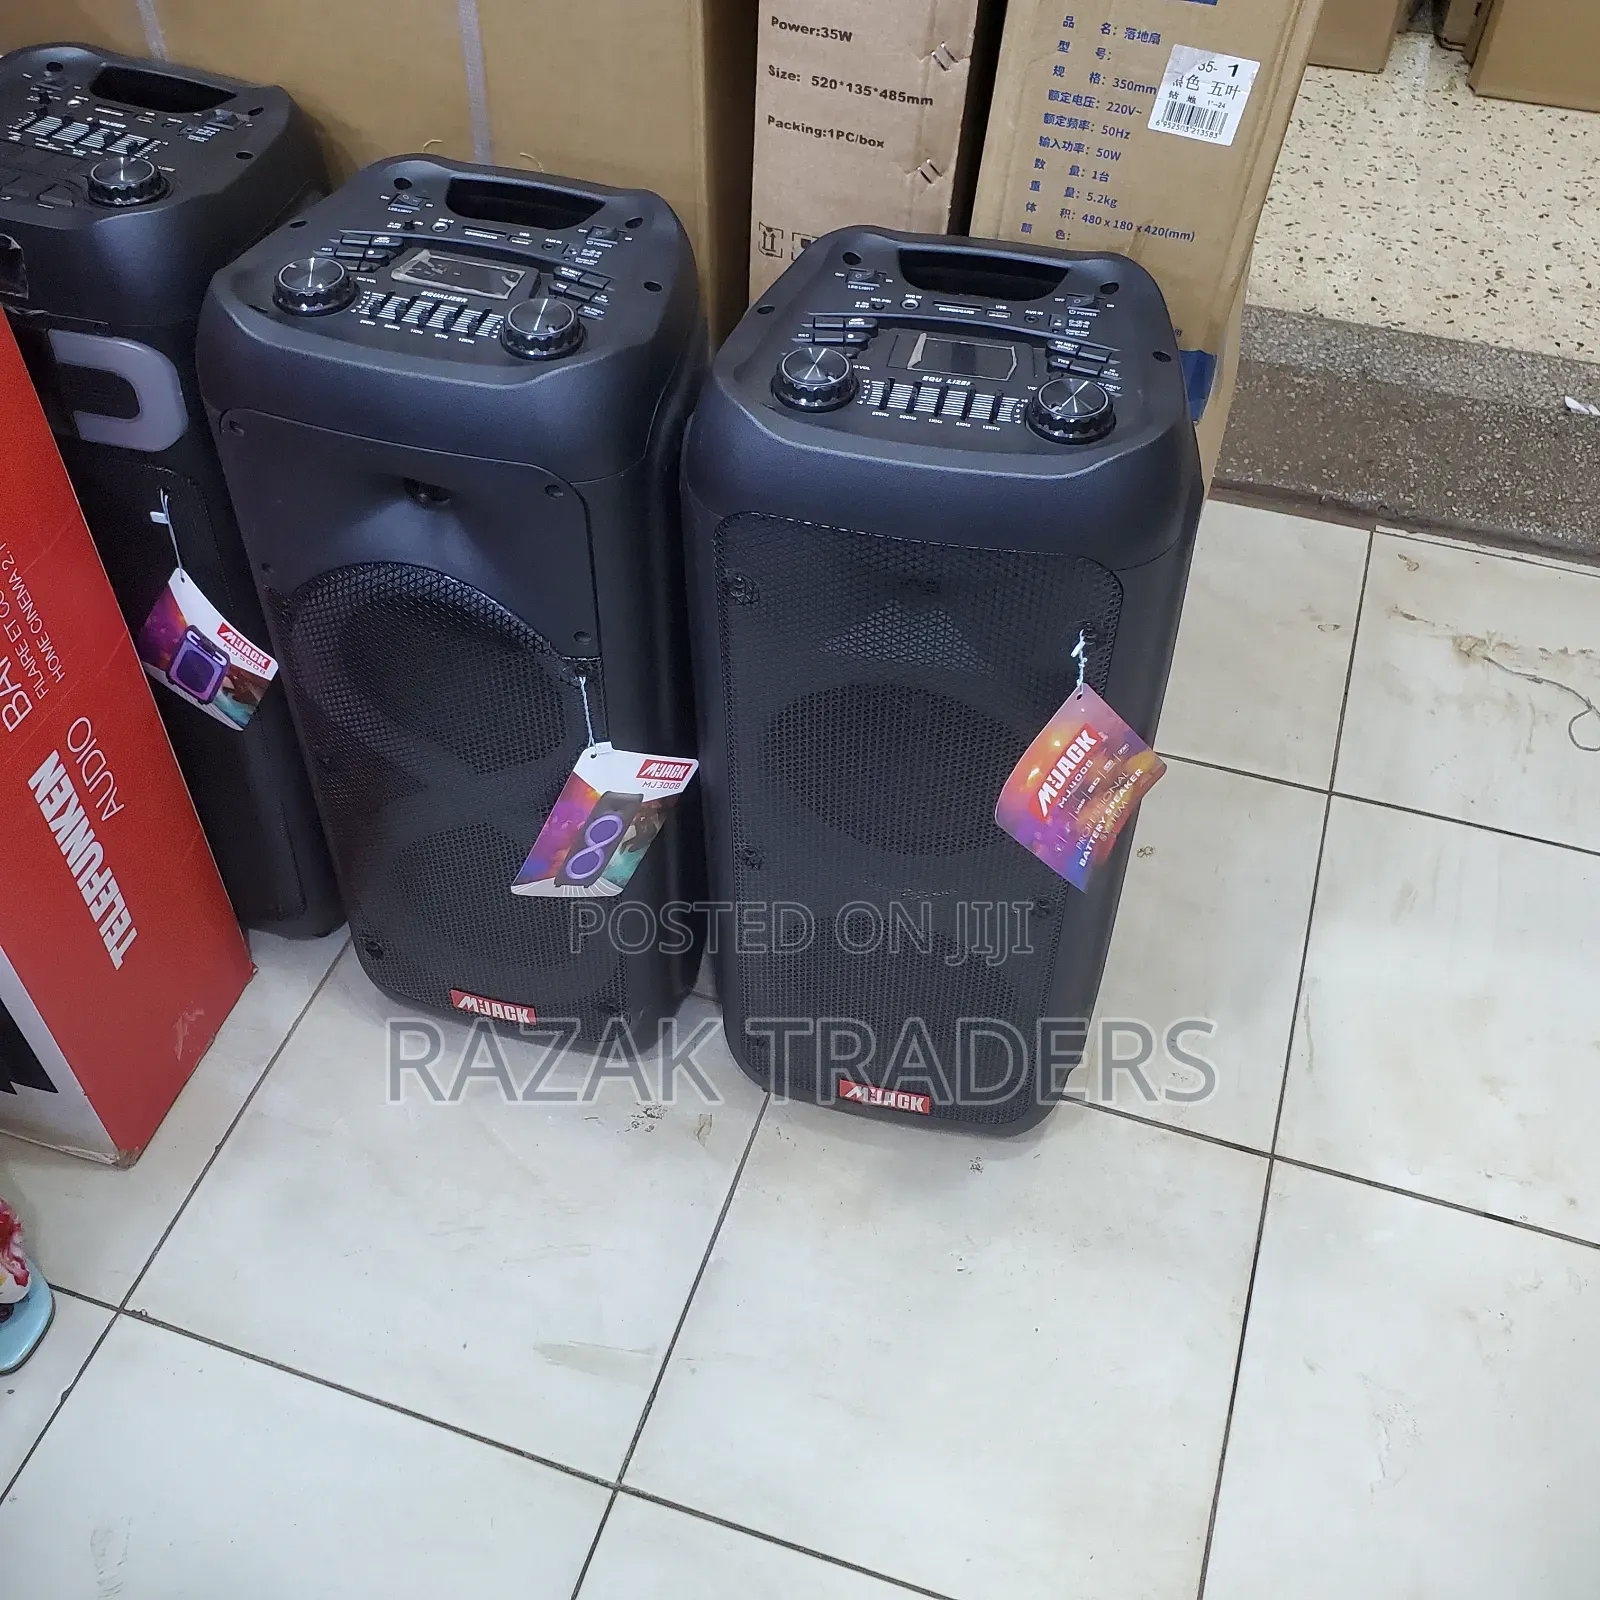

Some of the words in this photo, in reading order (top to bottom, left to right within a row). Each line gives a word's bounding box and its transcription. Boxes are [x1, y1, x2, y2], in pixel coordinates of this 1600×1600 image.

[771, 15, 853, 43] Power:35W
[768, 64, 801, 83] Size:
[767, 114, 885, 149] Packing:1PC/box
[421, 290, 469, 304] EQUALIZER
[8, 567, 43, 634] CINEMA
[3, 619, 22, 643] ET
[36, 631, 66, 684] HOME
[14, 639, 50, 700] FILAIRE
[66, 716, 126, 822] AUDIO
[1078, 815, 1107, 868] BATTERY
[1105, 768, 1144, 815] SPEAKER
[28, 749, 138, 971] TELEFUNKEN
